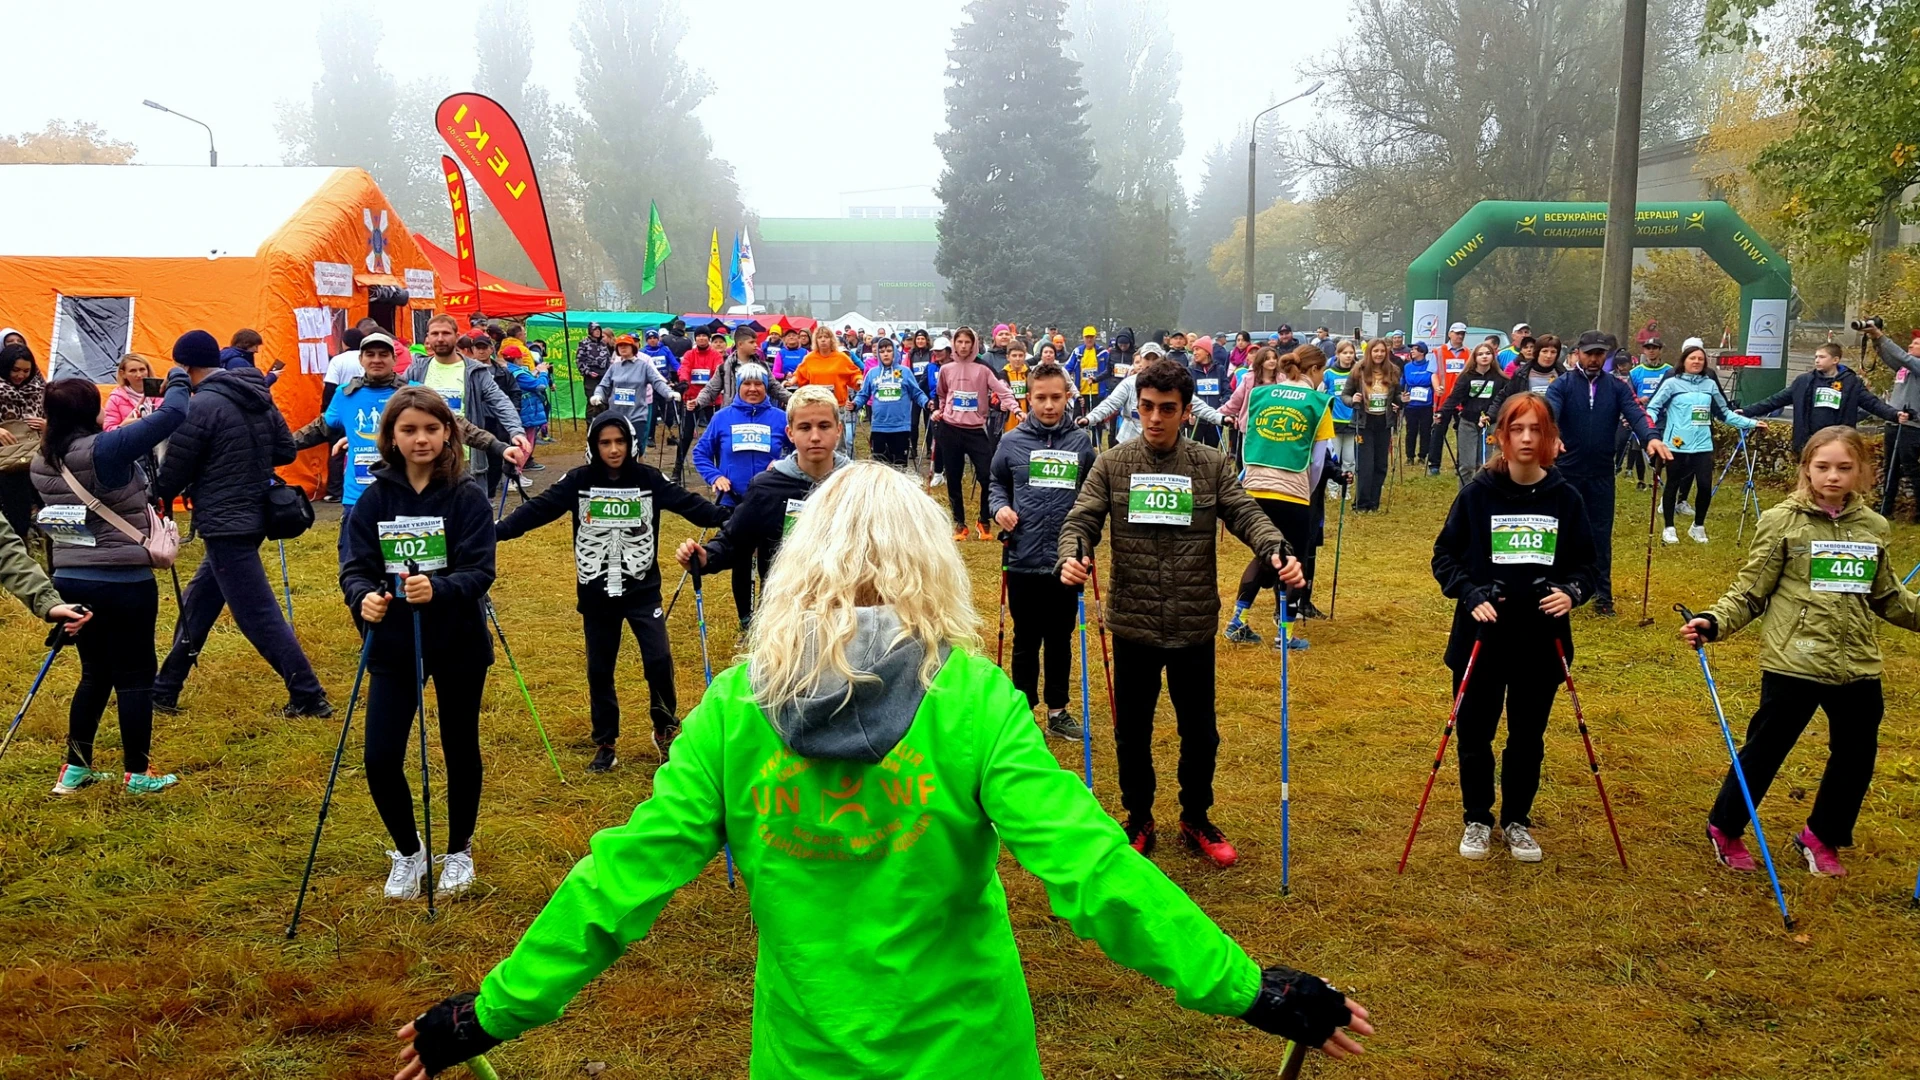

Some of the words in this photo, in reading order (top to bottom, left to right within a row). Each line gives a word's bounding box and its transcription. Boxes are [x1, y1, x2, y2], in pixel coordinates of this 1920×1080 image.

[1544, 210, 1608, 222] ВСЕУКРАЇНСЬ
[1543, 228, 1606, 238] СКАНДИНАВ
[1636, 225, 1678, 236] ХОДЬБИ
[1445, 232, 1484, 267] UNWF
[1733, 230, 1769, 265] UNWF
[443, 295, 469, 306] EKI
[1271, 389, 1306, 400] СУДДЯ
[960, 399, 970, 407] 36
[741, 433, 762, 443] 206
[1042, 464, 1067, 477] 447
[1144, 493, 1178, 510] 403
[602, 503, 630, 516] 400
[1508, 533, 1543, 549] 448
[394, 539, 428, 557] 402
[1830, 560, 1865, 577] 446
[751, 785, 801, 815] UN
[879, 772, 936, 806] WF
